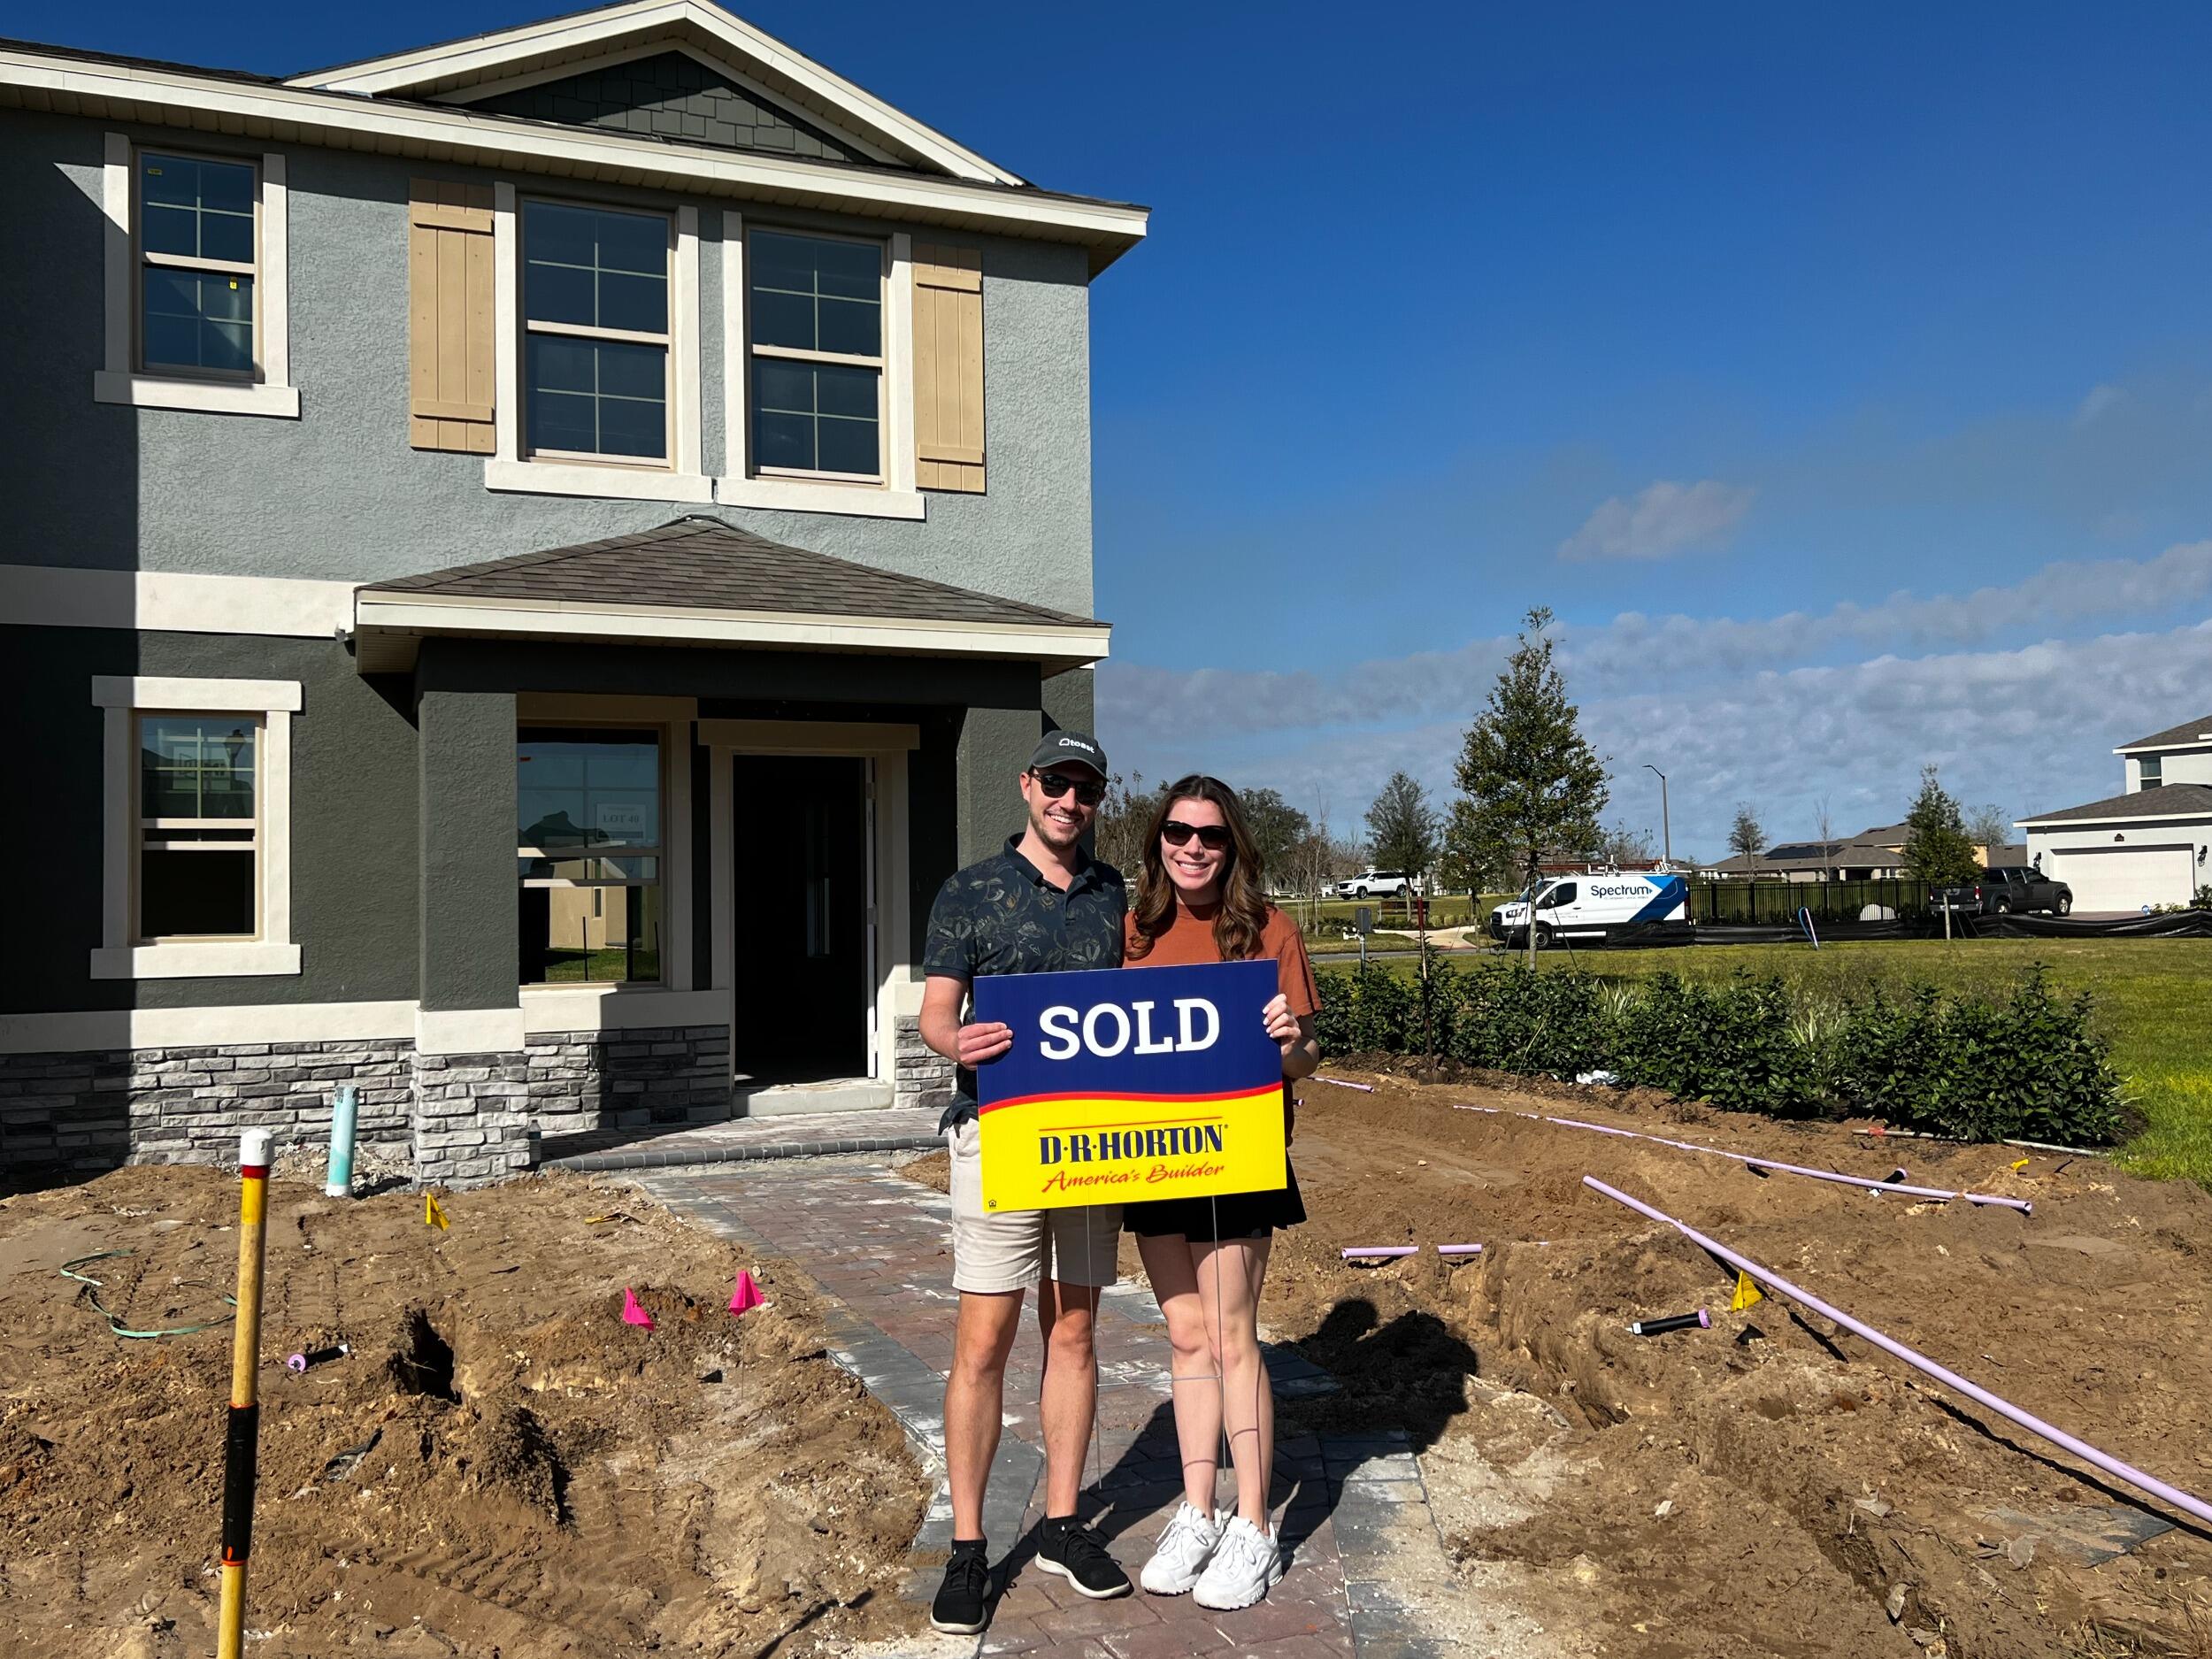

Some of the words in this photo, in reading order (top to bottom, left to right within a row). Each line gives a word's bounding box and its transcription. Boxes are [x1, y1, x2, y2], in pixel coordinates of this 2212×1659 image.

[1070, 739, 1095, 754] toast
[603, 813, 626, 823] LOT
[1590, 884, 1649, 899] Spectrum
[1039, 997, 1220, 1061] SOLD
[1041, 1169, 1141, 1194] America's
[1145, 1161, 1225, 1184] Builder
